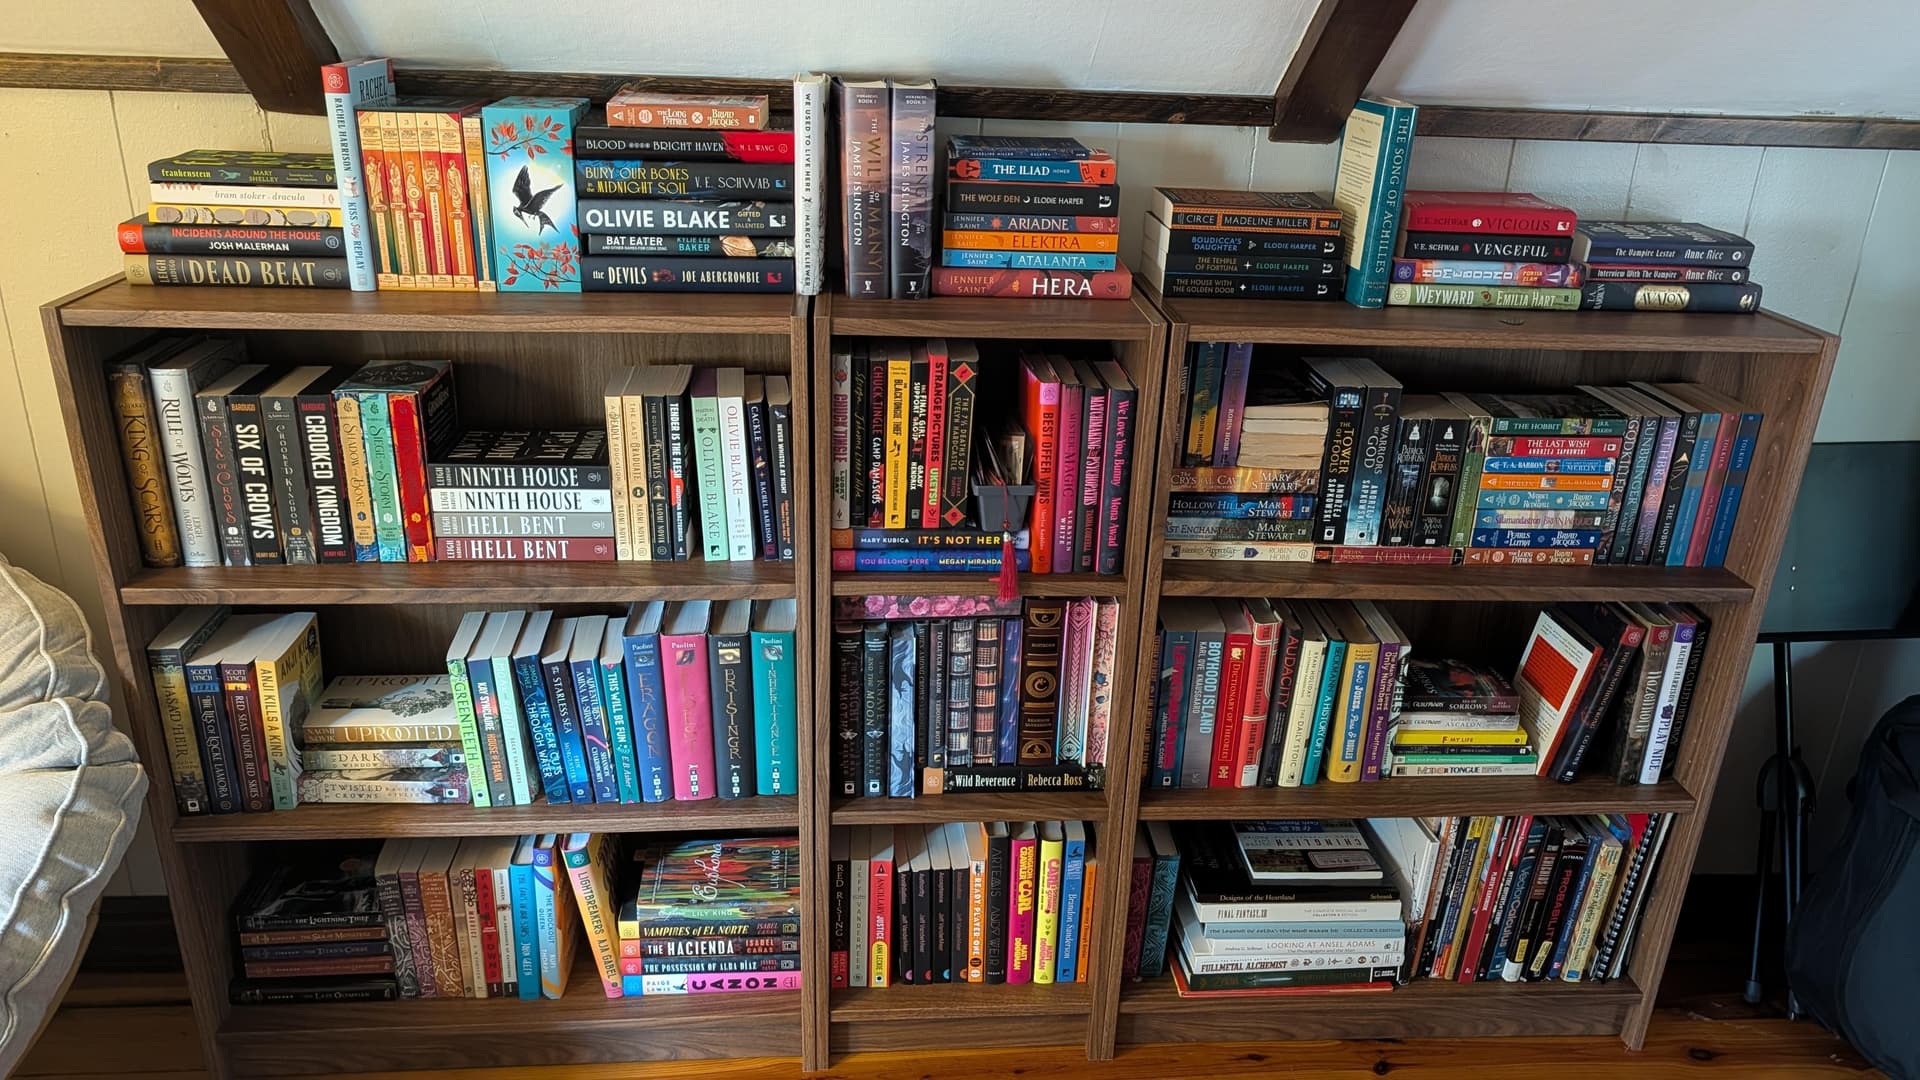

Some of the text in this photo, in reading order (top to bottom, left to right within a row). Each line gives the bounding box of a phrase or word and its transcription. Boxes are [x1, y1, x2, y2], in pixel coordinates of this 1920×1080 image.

[585, 139, 724, 152] BLOOD BRIGHT HAVEN
[161, 168, 211, 179] frankenstein
[585, 166, 688, 180] BURY OUR BONES
[993, 165, 1015, 175] THE
[1019, 165, 1050, 175] ILIAD
[597, 181, 688, 194] MIDNIGHT SOIL
[850, 140, 863, 246] JAMES ISLINGTON
[214, 191, 305, 201] bram stoker dracula
[960, 194, 1083, 205] THE WOLF DEN ELODIE HARPER
[1375, 115, 1410, 275] THE SONG OF ACHILLES
[586, 209, 730, 229] OLIVIE BLAKE
[953, 215, 985, 223] JENNIFER
[1008, 218, 1069, 230] ARIADNE
[1186, 214, 1309, 227] CIRCE MADELINE MILLER
[1486, 216, 1550, 232] VICIOUS
[172, 227, 321, 240] INCIDENTS AROUND THE HOUSE
[209, 241, 289, 251] JOSH MALERMAN
[606, 236, 663, 246] BAT EATER
[678, 242, 711, 252] BAKER
[1012, 234, 1080, 249] ELEKTRA
[1194, 243, 1239, 252] DAUGHTER
[1017, 255, 1087, 267] ATALANTA
[188, 259, 318, 287] DEAD BEAT
[592, 267, 761, 286] the DEVILS JOE ABERCROMBIE
[950, 275, 995, 285] JENNIFER
[1032, 277, 1093, 295] HERA
[1415, 284, 1555, 307] WEYWARD EMILIA HART
[1532, 423, 1561, 431] HOBBIT
[928, 362, 944, 506] STRANGE PICTURES UKETSU
[1545, 440, 1565, 449] LAST
[1567, 441, 1590, 449] WISH
[1039, 412, 1054, 505] BEST OFFER WINS
[1612, 419, 1641, 498] GODKILLER
[1629, 420, 1657, 507] SUNBRINGER
[459, 466, 579, 486] NINTH HOUSE
[871, 437, 883, 505] CAMP DAMASCUS
[1262, 472, 1290, 483] MARY
[235, 423, 276, 541] SIX OF CROWS
[305, 414, 345, 548] CROOKED KINGDOM
[1252, 482, 1302, 492] STEWART
[702, 436, 720, 540] OLIVIE BLAKE
[465, 492, 582, 509] NINTH HOUSE
[1172, 500, 1246, 510] HOLLOW HILLS
[1258, 500, 1288, 509] MARY
[1248, 508, 1295, 518] STEWART
[467, 516, 566, 534] HELL BENT
[1258, 523, 1287, 533] MARY
[918, 536, 940, 545] IT'S
[946, 537, 971, 545] NOT
[976, 536, 1000, 545] HER
[1248, 531, 1295, 541] STEWART
[469, 541, 568, 559] HELL BENT
[966, 559, 1003, 567] MIRANDA
[632, 643, 654, 651] Paolini
[671, 641, 697, 650] Paolini
[718, 640, 741, 648] Paolini
[761, 638, 783, 646] Paolini
[1277, 635, 1299, 708] AUDACITY
[1199, 641, 1222, 735] BOYHOOD ISLAND
[553, 677, 572, 735] STARLESS SEA
[1448, 702, 1488, 711] SORROWS
[261, 669, 282, 758] ANJI KILLS KING
[725, 669, 741, 759] BRISINGR
[455, 683, 480, 762] GREENTEETH
[527, 703, 545, 748] THROUGH
[344, 726, 453, 743] UPROOTED
[338, 752, 381, 762] DARK
[1450, 765, 1481, 773] TONGUE
[955, 774, 1016, 786] Wild Reverence
[1028, 774, 1083, 786] Rebecca Ross
[331, 784, 382, 793] TWISTED
[771, 848, 782, 869] KING
[692, 843, 745, 901] Euphoria
[974, 877, 982, 905] READY
[1018, 880, 1033, 915] CARL
[1499, 865, 1532, 948] Vector Calculus
[546, 908, 554, 944] KNOCKOUT
[577, 871, 618, 979] LIGHTBREAKERS AJA GABEL
[876, 915, 885, 940] JUSTICE
[973, 906, 981, 937] PLAYER
[1063, 894, 1078, 959] Brandon Sanderson
[643, 925, 750, 937] VAMPIRES of EL NORTE
[648, 940, 735, 955] THE HACIENDA
[1266, 941, 1304, 949] LOOKING
[1306, 941, 1317, 949] AT
[1346, 940, 1376, 948] ADAMS
[1200, 960, 1288, 972] FULLMETAL ALCHEMIST
[692, 977, 778, 990] CANON
